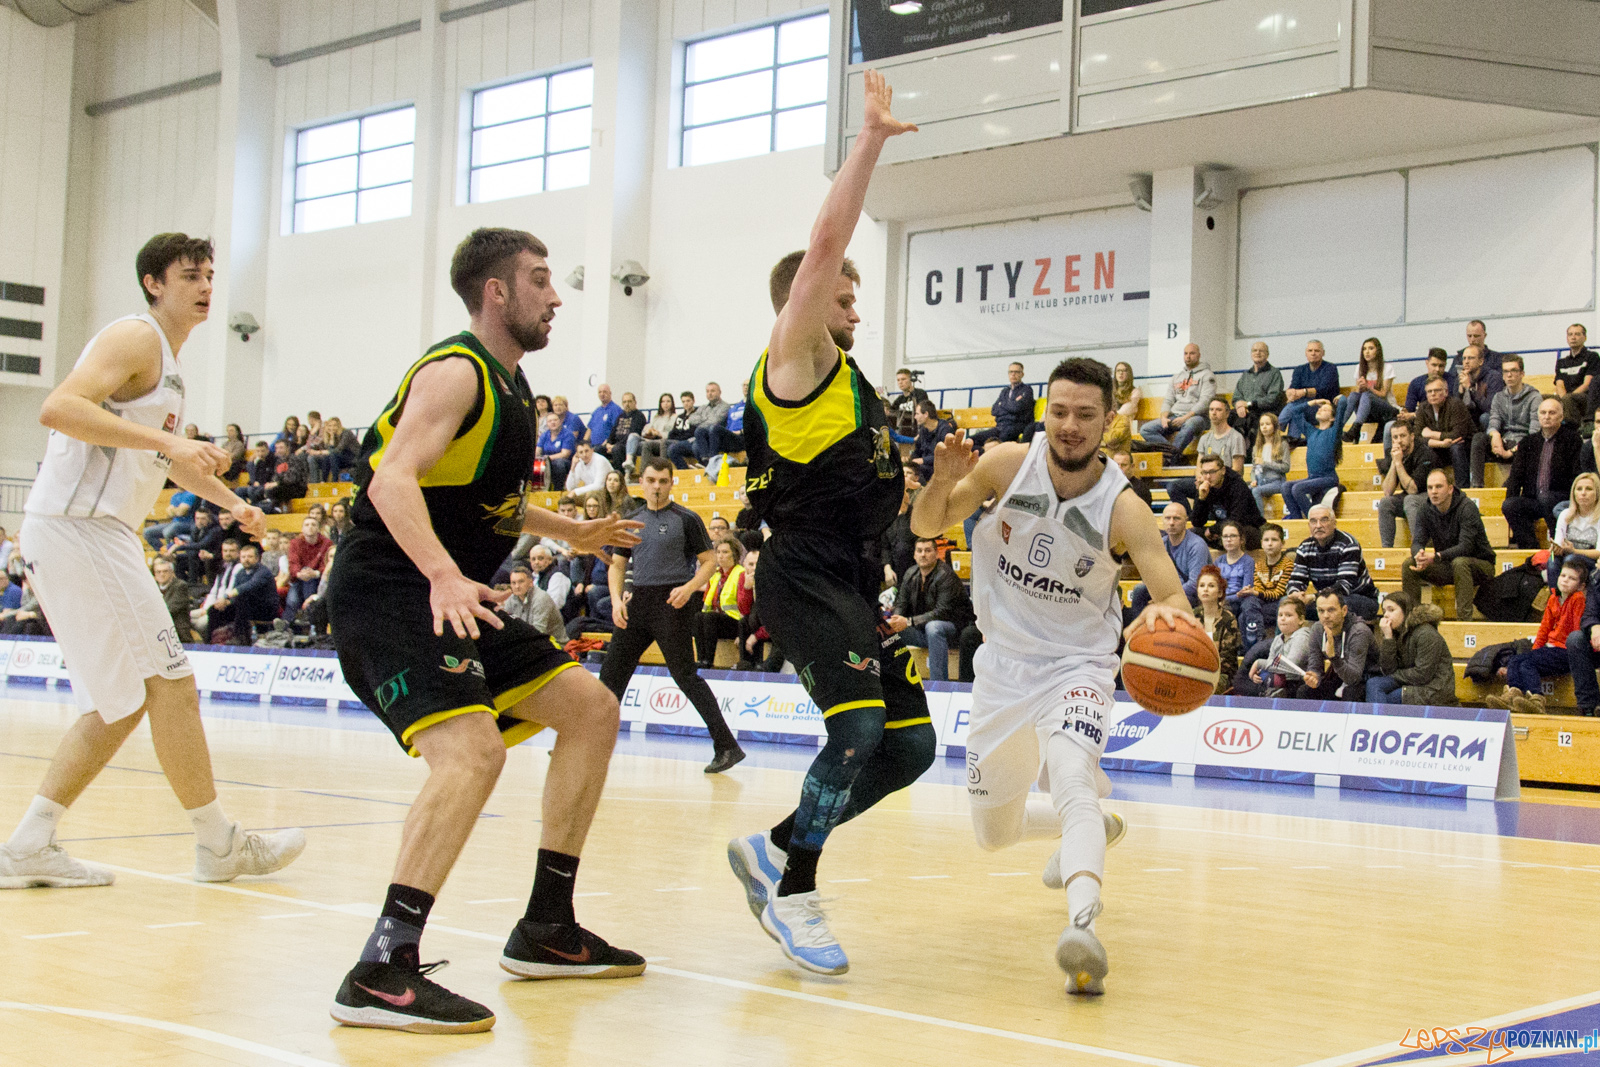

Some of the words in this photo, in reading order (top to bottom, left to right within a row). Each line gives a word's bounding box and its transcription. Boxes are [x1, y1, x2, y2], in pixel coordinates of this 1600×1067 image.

[925, 250, 1116, 306] CITYZEN
[979, 302, 1011, 314] WIĘCEJ
[1034, 299, 1059, 309] KLUB
[1063, 293, 1115, 307] SPORTOWY
[1167, 323, 1178, 339] B
[1027, 532, 1055, 569] 6
[998, 553, 1081, 598] BIOFARM
[1465, 636, 1476, 646] 15
[278, 666, 335, 684] BIOFARM
[1542, 685, 1553, 694] 13
[655, 692, 680, 709] KIA
[1064, 705, 1103, 725] DELIK
[1109, 721, 1150, 739] atrem
[1213, 726, 1252, 747] KIA
[1277, 730, 1338, 752] DELIK
[1349, 728, 1488, 762] BIOFARM
[1559, 734, 1571, 745] 12
[1358, 757, 1386, 766] POLSKI
[1389, 760, 1438, 770] PRODUCENT
[1442, 761, 1472, 773] LEKÓW
